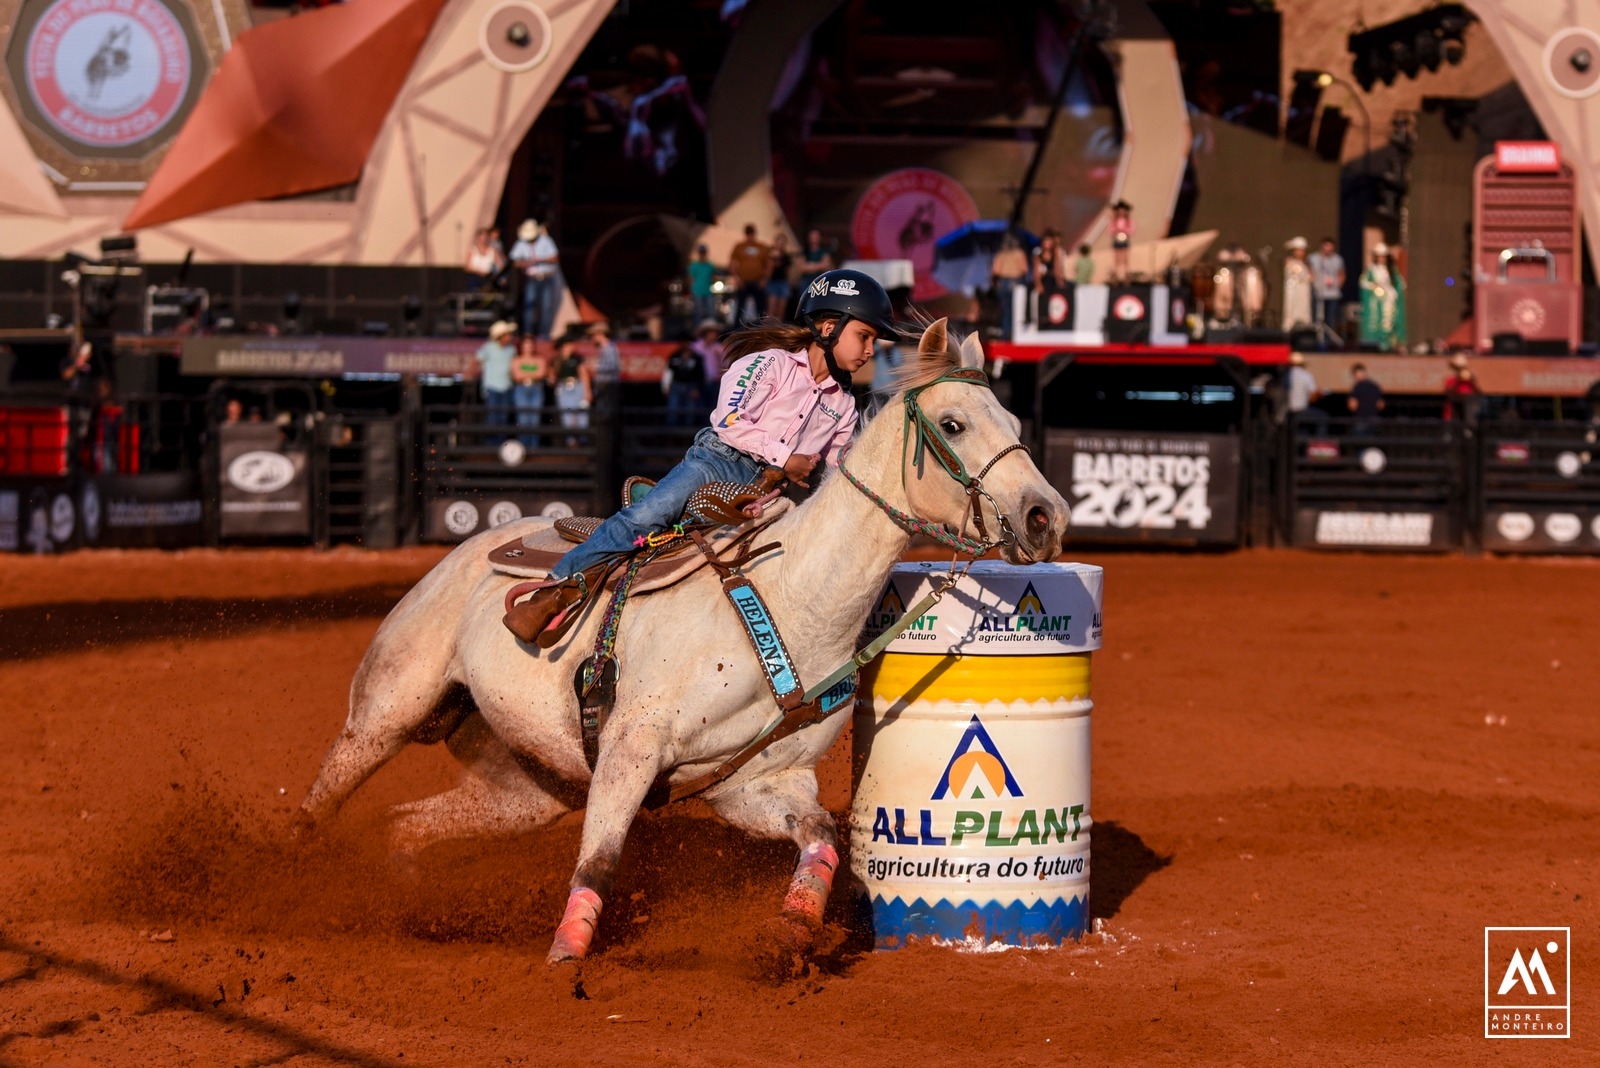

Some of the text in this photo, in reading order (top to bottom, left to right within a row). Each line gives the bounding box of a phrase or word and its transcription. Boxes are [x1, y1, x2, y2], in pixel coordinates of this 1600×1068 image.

[1072, 452, 1211, 486] BARRETOS
[1070, 482, 1212, 529] 2024
[737, 596, 785, 678] HELENA
[908, 632, 937, 640] futuro
[978, 632, 1071, 643] agricultura do futuro
[868, 855, 1085, 882] agricultura do futuro
